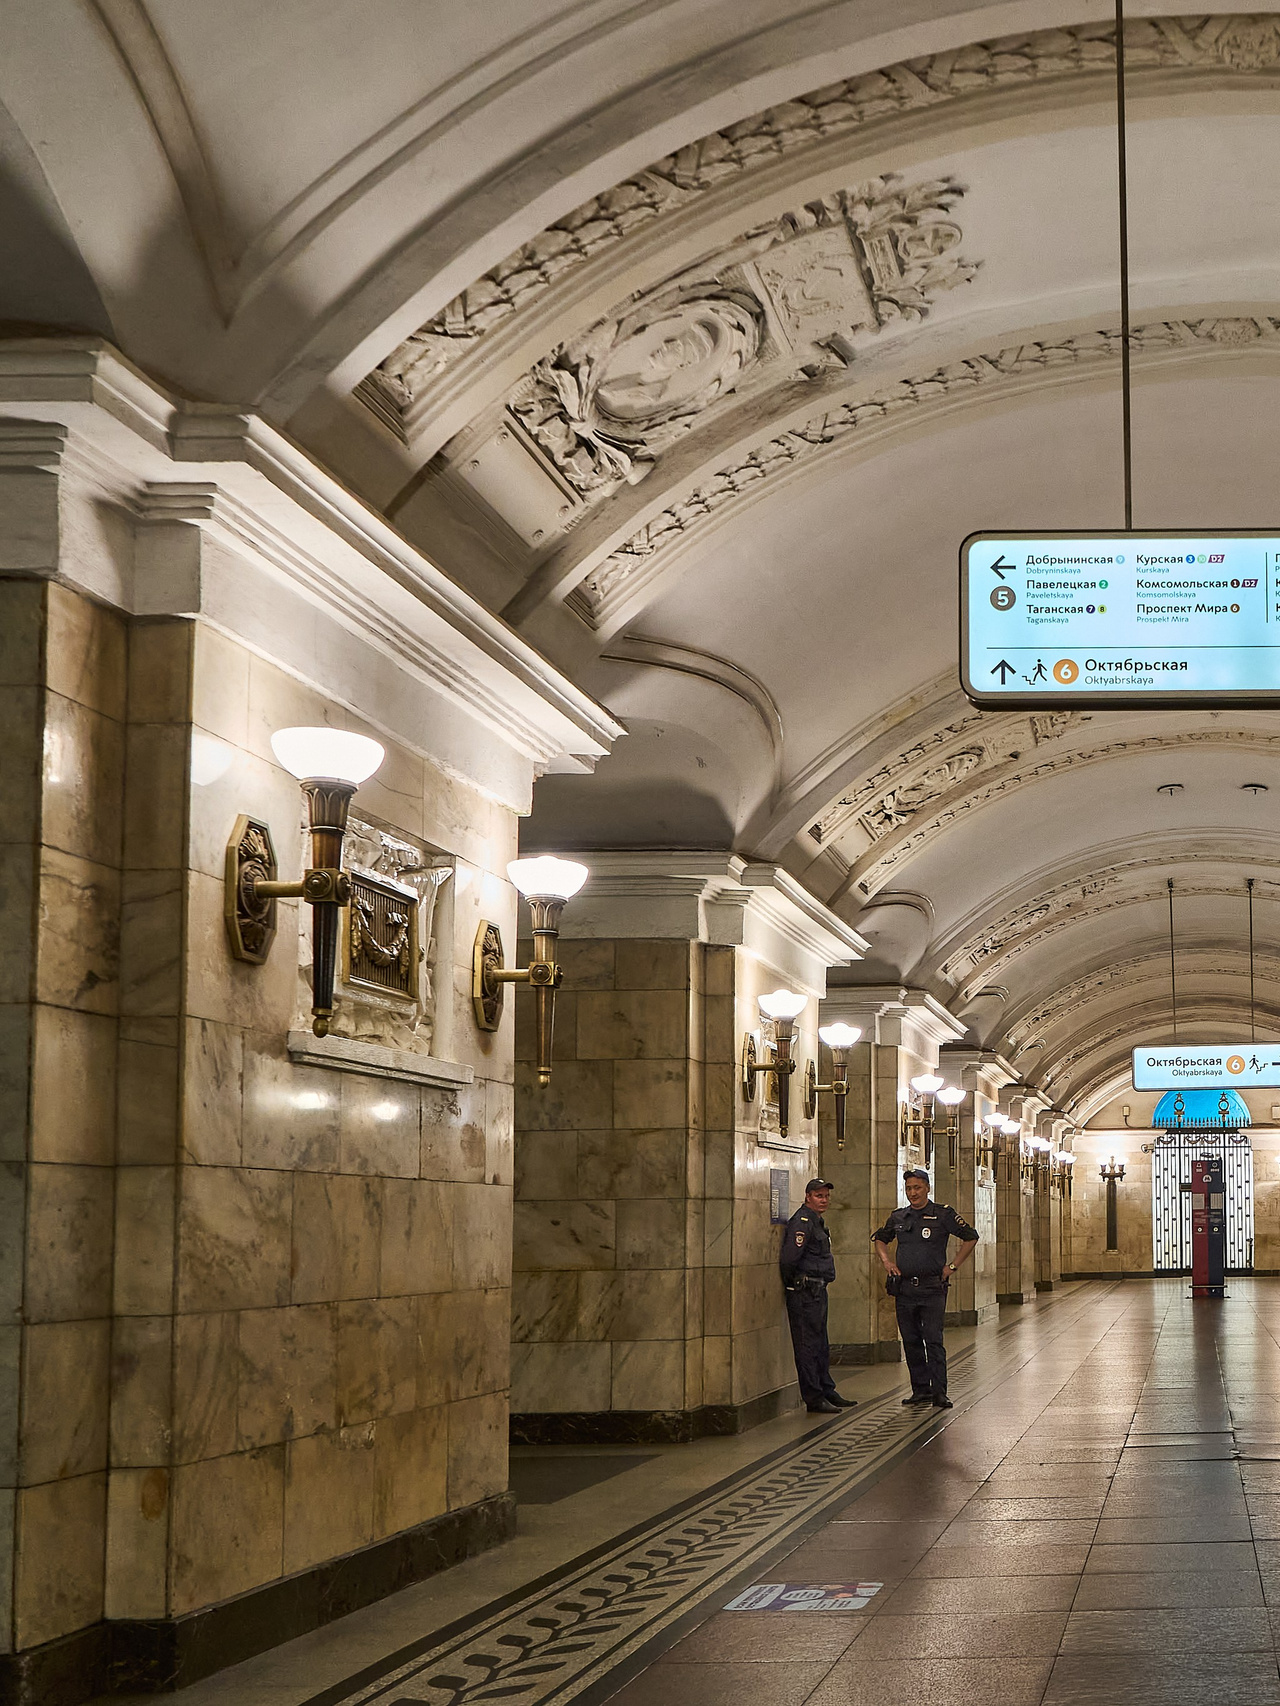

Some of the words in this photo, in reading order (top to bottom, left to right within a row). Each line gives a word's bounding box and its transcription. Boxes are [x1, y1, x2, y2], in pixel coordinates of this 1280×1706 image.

[1026, 555, 1113, 565] Добрынинская
[1136, 555, 1183, 565] Курская
[1026, 567, 1081, 575] Dobryninskaya
[1027, 580, 1096, 590] Павелецкая
[1137, 579, 1228, 588] Комсомольская
[996, 591, 1009, 606] 5
[1026, 592, 1073, 600] Paveletskaya
[1137, 591, 1196, 599] Komsomolskaya
[1027, 605, 1083, 615] Таганская
[1137, 604, 1192, 615] Проспект
[1195, 603, 1227, 614] Мира
[1026, 617, 1069, 625] Taganskaya
[1137, 616, 1169, 624] Prospekt
[1060, 663, 1072, 680] 6
[1085, 659, 1187, 674] Октябрьская
[1085, 675, 1154, 685] Oktyabrskaya
[1147, 1057, 1222, 1068] Октябрьская
[1231, 1058, 1238, 1071] 6
[1172, 1069, 1222, 1077] Oktyabrskaya
